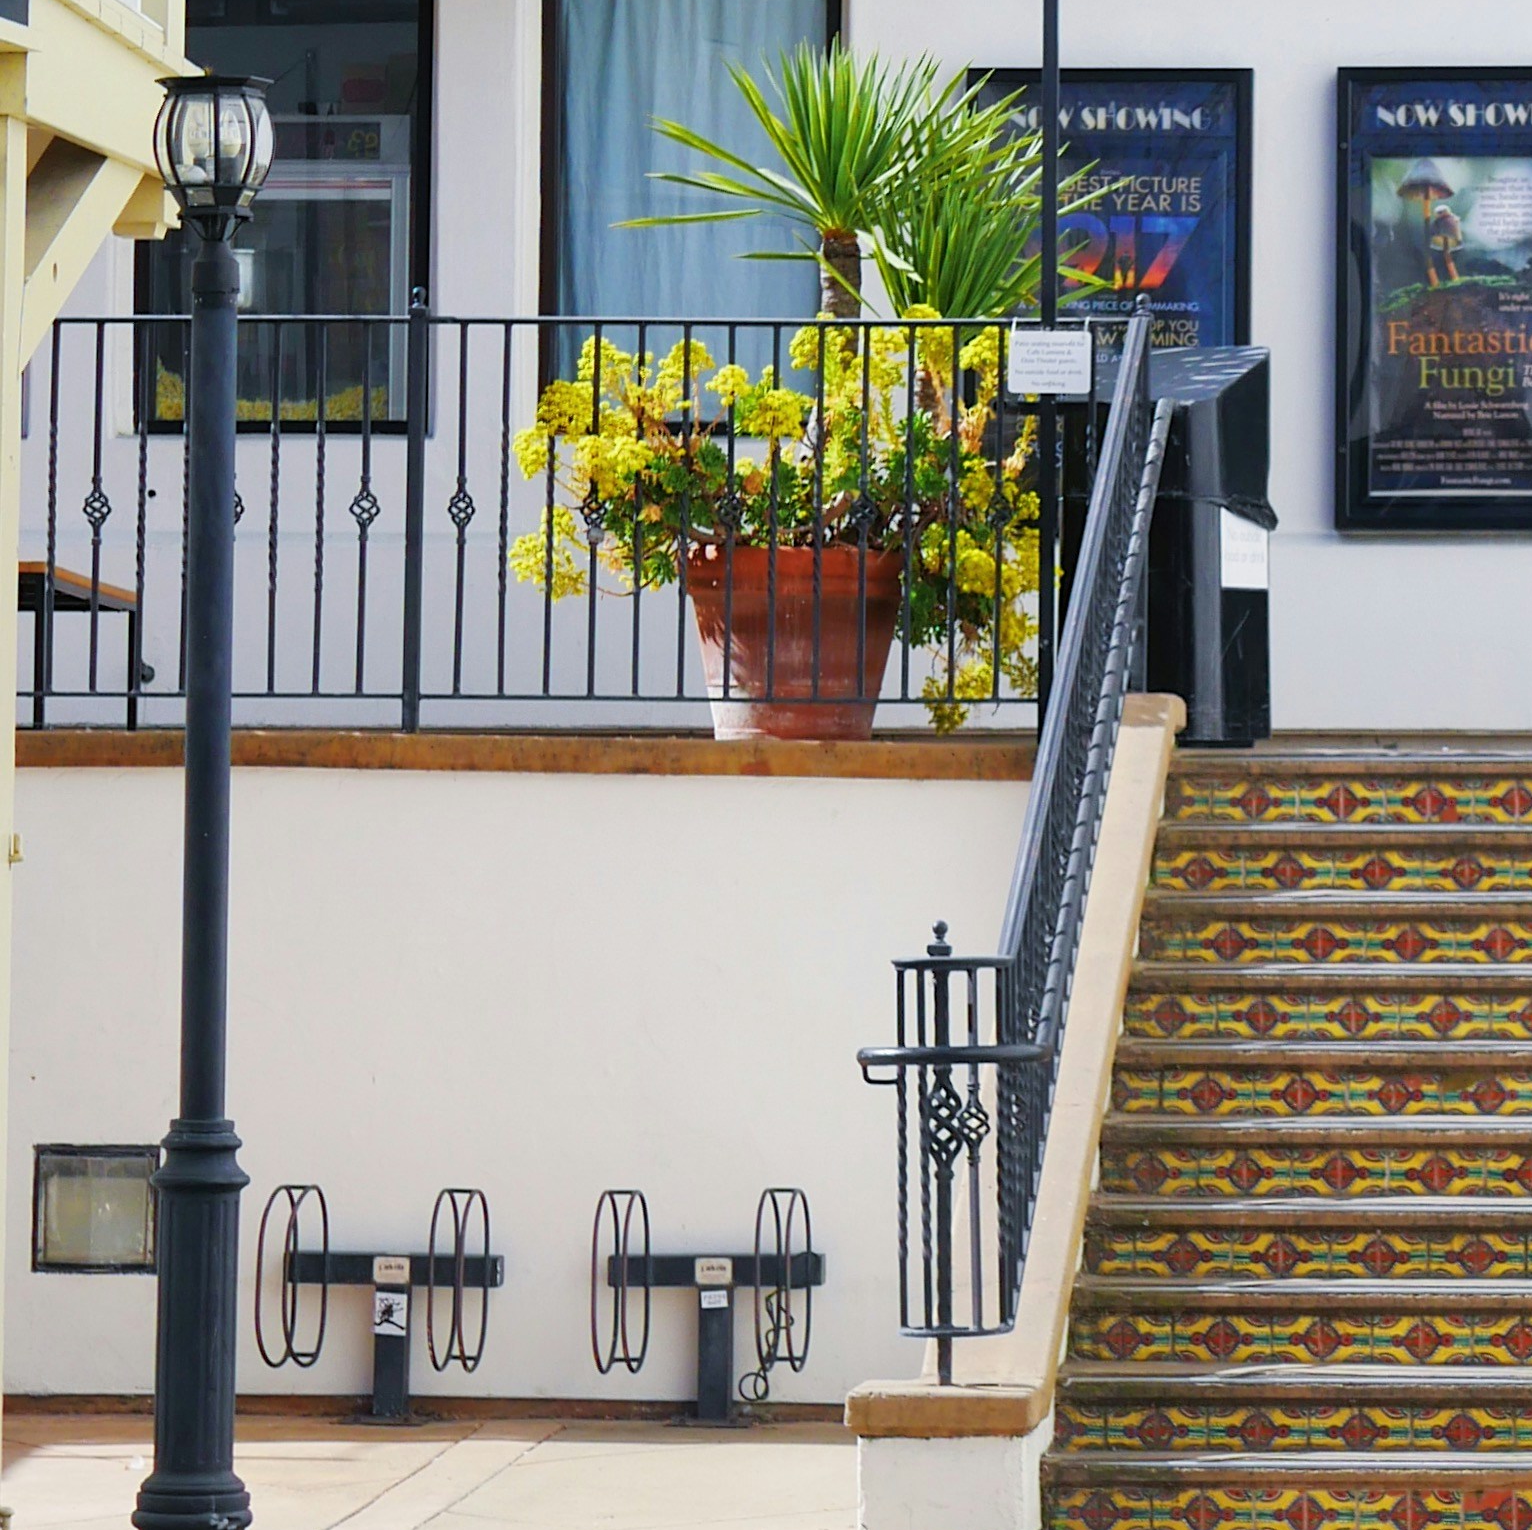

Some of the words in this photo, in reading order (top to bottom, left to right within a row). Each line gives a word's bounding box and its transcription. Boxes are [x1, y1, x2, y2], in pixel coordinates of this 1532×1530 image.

[1080, 103, 1211, 130] SHOWING
[1376, 103, 1443, 127] NOW
[1112, 193, 1171, 212] YEAR
[1180, 193, 1201, 212] IS
[1092, 300, 1119, 311] PIECE
[1169, 317, 1200, 333] YOU
[1418, 355, 1516, 397] Fungi
